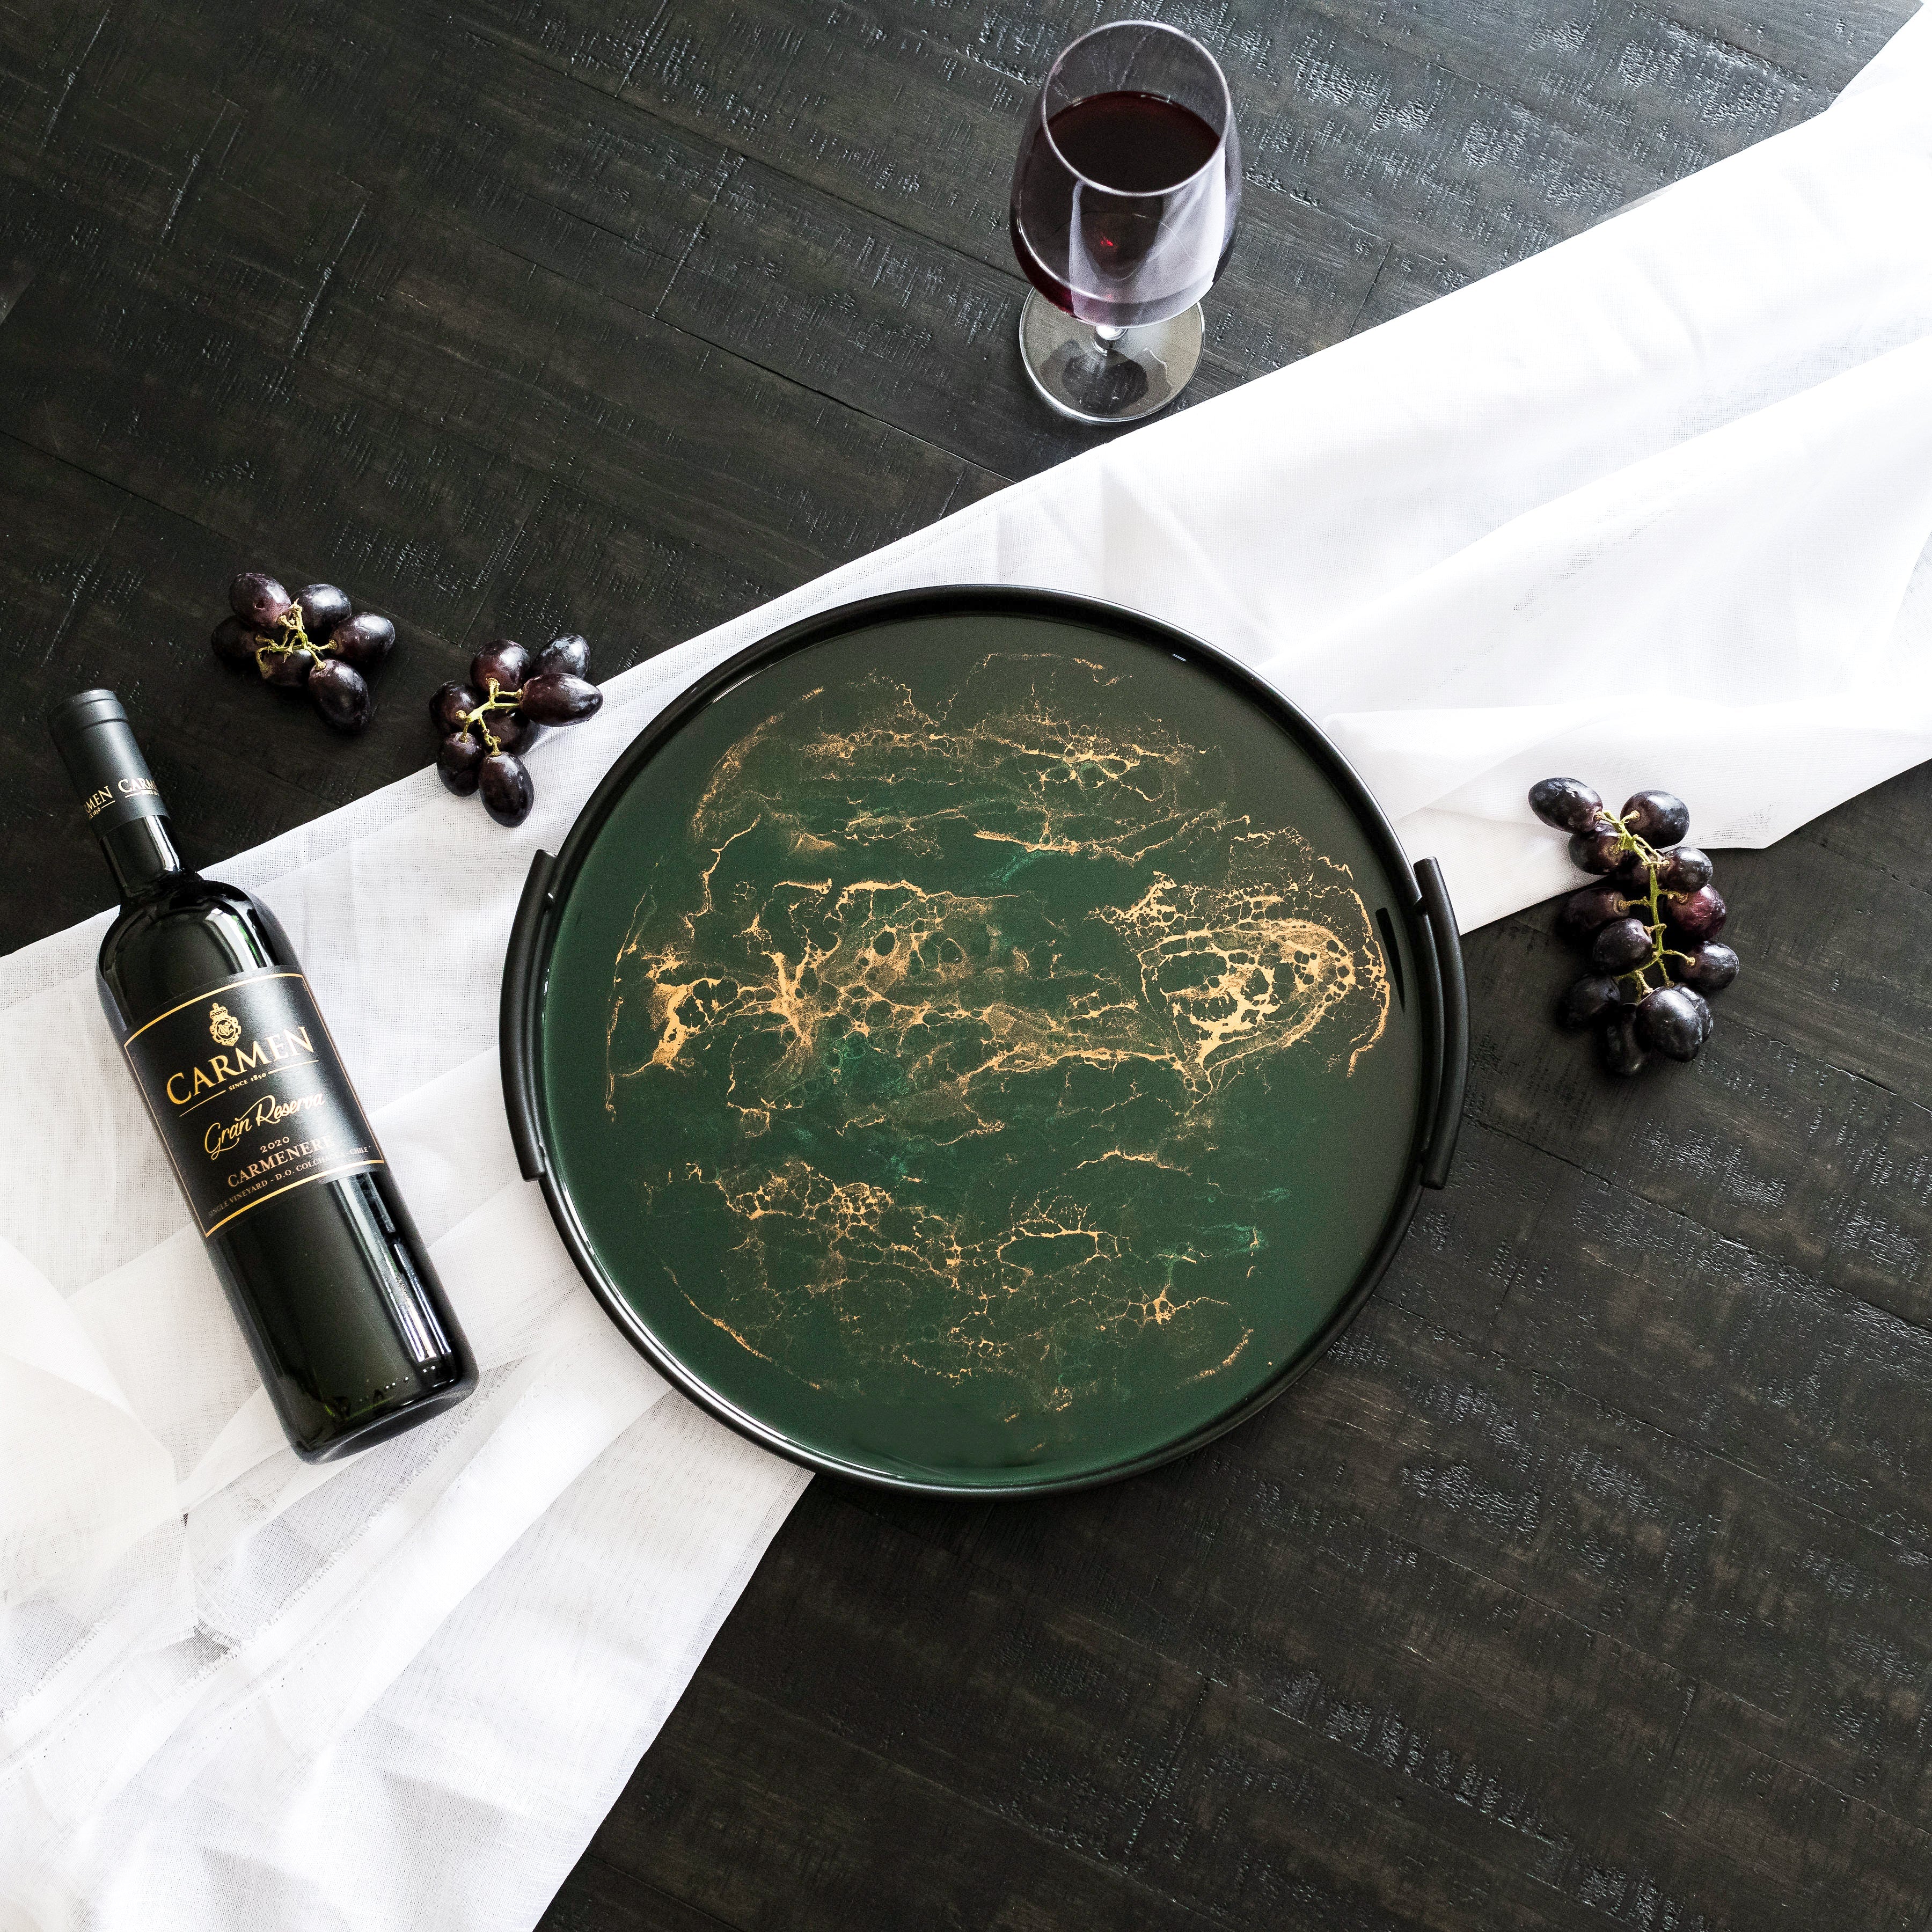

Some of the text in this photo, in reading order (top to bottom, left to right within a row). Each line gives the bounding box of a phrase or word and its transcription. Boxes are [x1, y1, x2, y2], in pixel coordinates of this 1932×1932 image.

[167, 1026, 314, 1104] CARMEN
[229, 1073, 267, 1091] SINCE 1850
[204, 1093, 325, 1160] Gran Reserva
[260, 1136, 290, 1153] 2020
[208, 1200, 230, 1218] SINGLE
[229, 1180, 268, 1203] VINEYARD
[275, 1169, 295, 1180] D.O.
[350, 1146, 369, 1155] CHILE
[228, 1135, 335, 1187] CARMENERE
